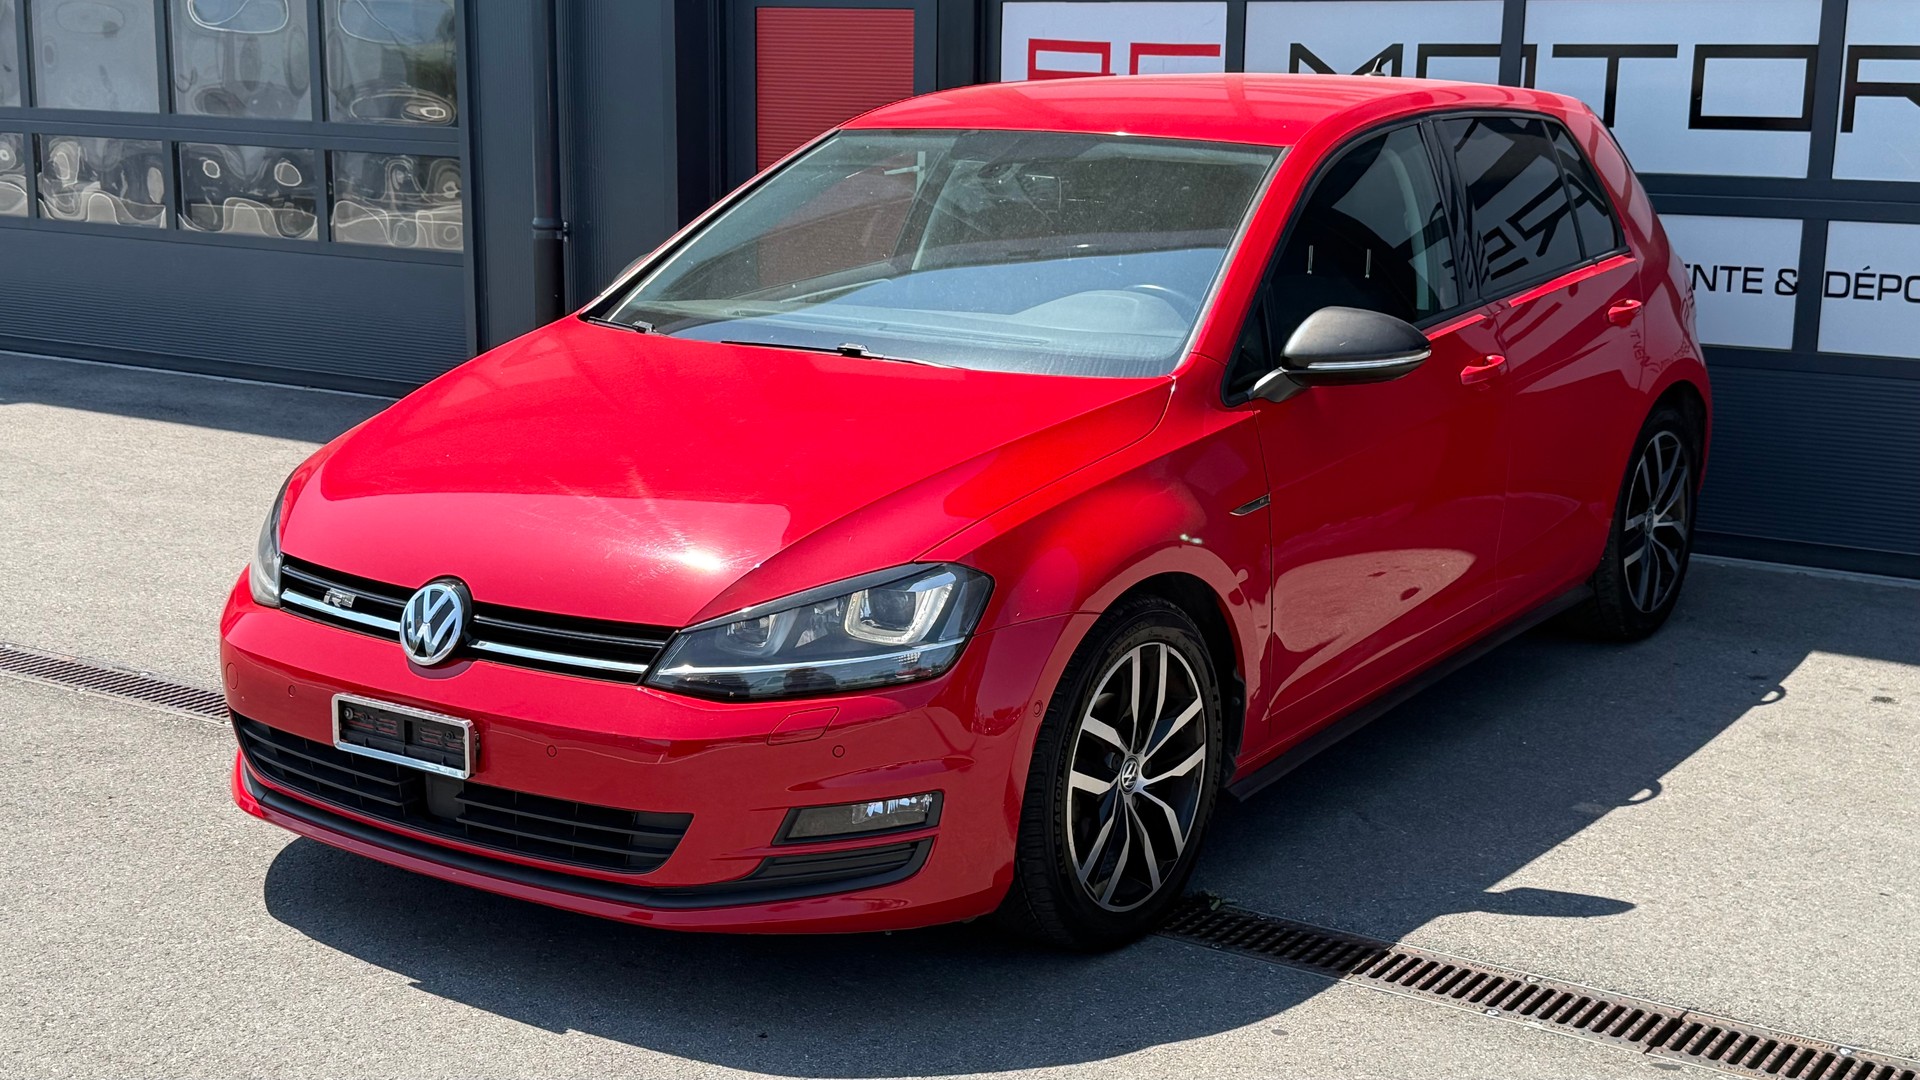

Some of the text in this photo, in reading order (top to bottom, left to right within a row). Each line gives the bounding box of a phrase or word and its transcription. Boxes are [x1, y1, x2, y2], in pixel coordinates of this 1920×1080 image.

[1684, 264, 1764, 294] NTE
[1774, 268, 1798, 296] &
[402, 585, 461, 663] VW
[1053, 775, 1067, 875] ALL SEASON
